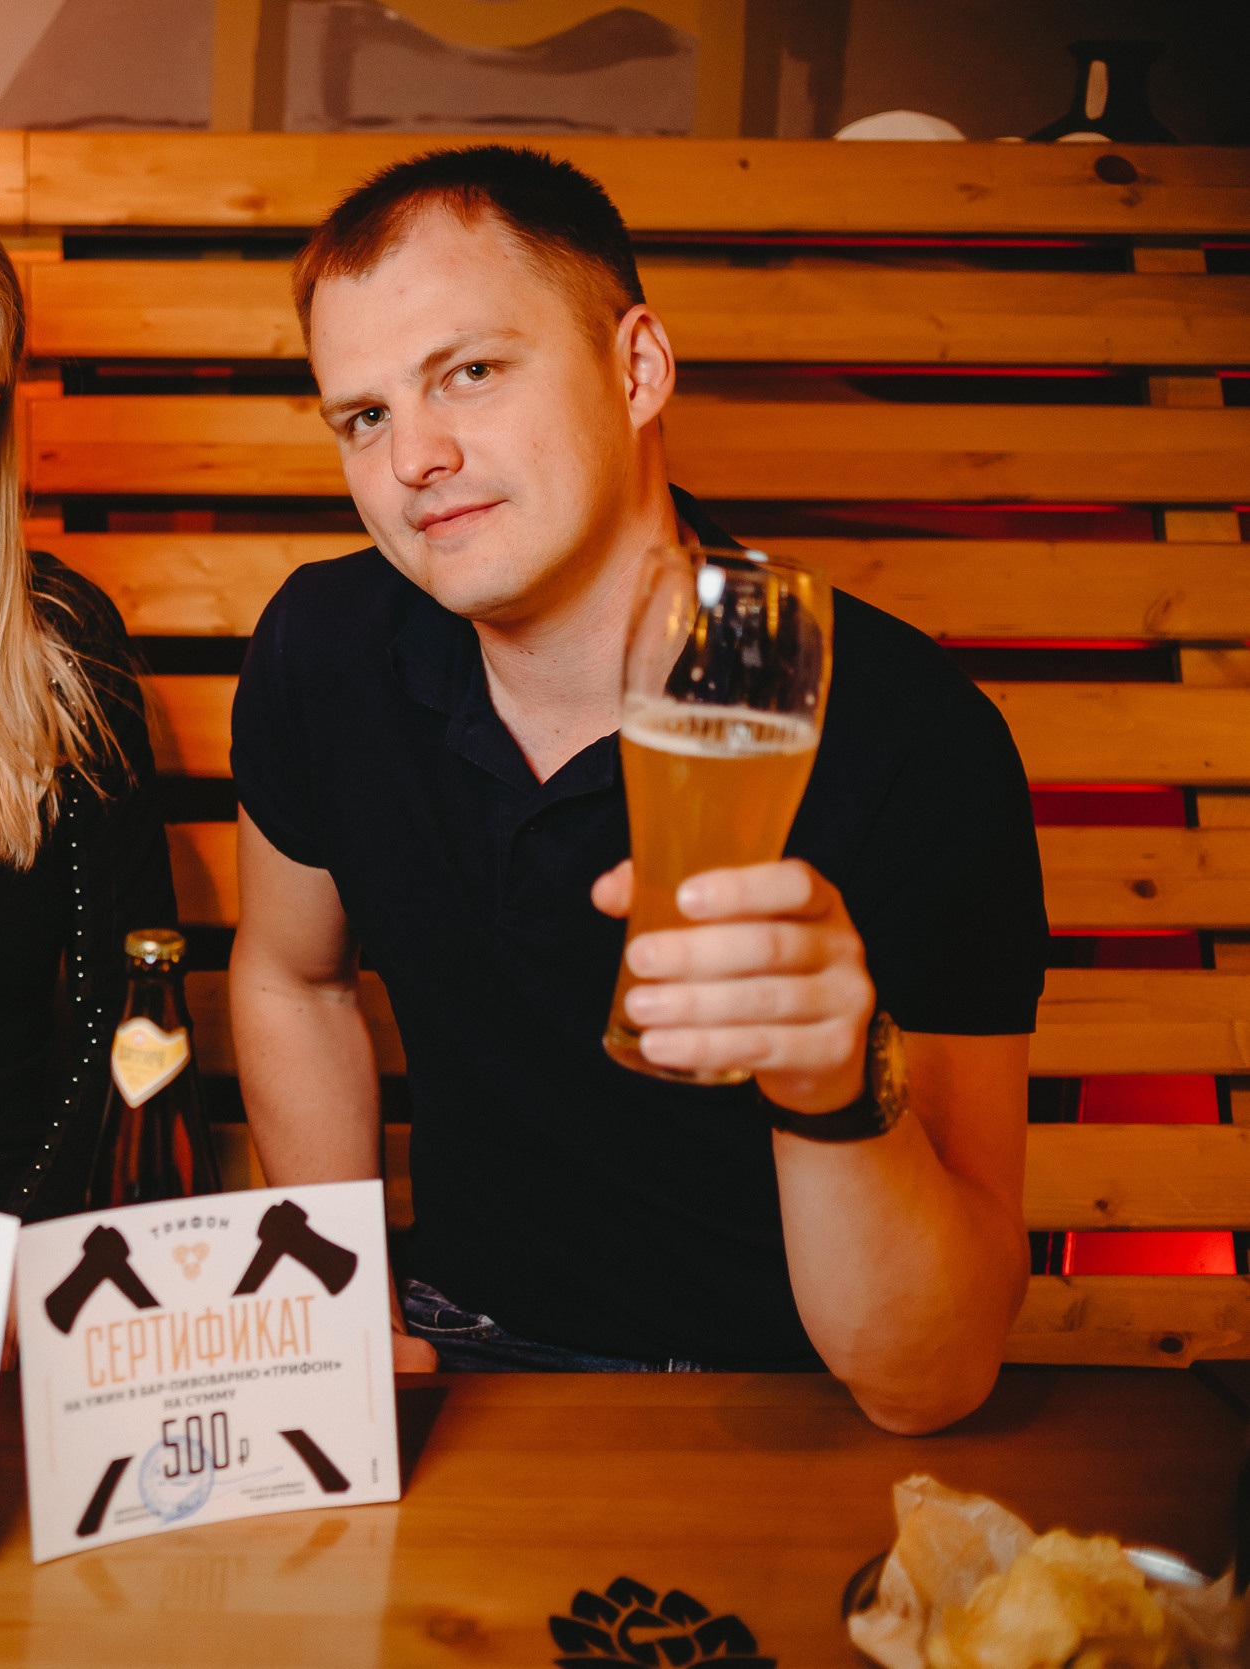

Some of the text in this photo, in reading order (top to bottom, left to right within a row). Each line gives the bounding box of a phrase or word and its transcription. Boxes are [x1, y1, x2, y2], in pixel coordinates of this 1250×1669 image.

[151, 1215, 230, 1240] ТРИФОН
[85, 1294, 316, 1388] СЕРТИФИКАТ
[263, 1359, 342, 1379] «ТРИФОН»
[163, 1388, 237, 1410] НА СУММУ
[161, 1411, 230, 1479] 500
